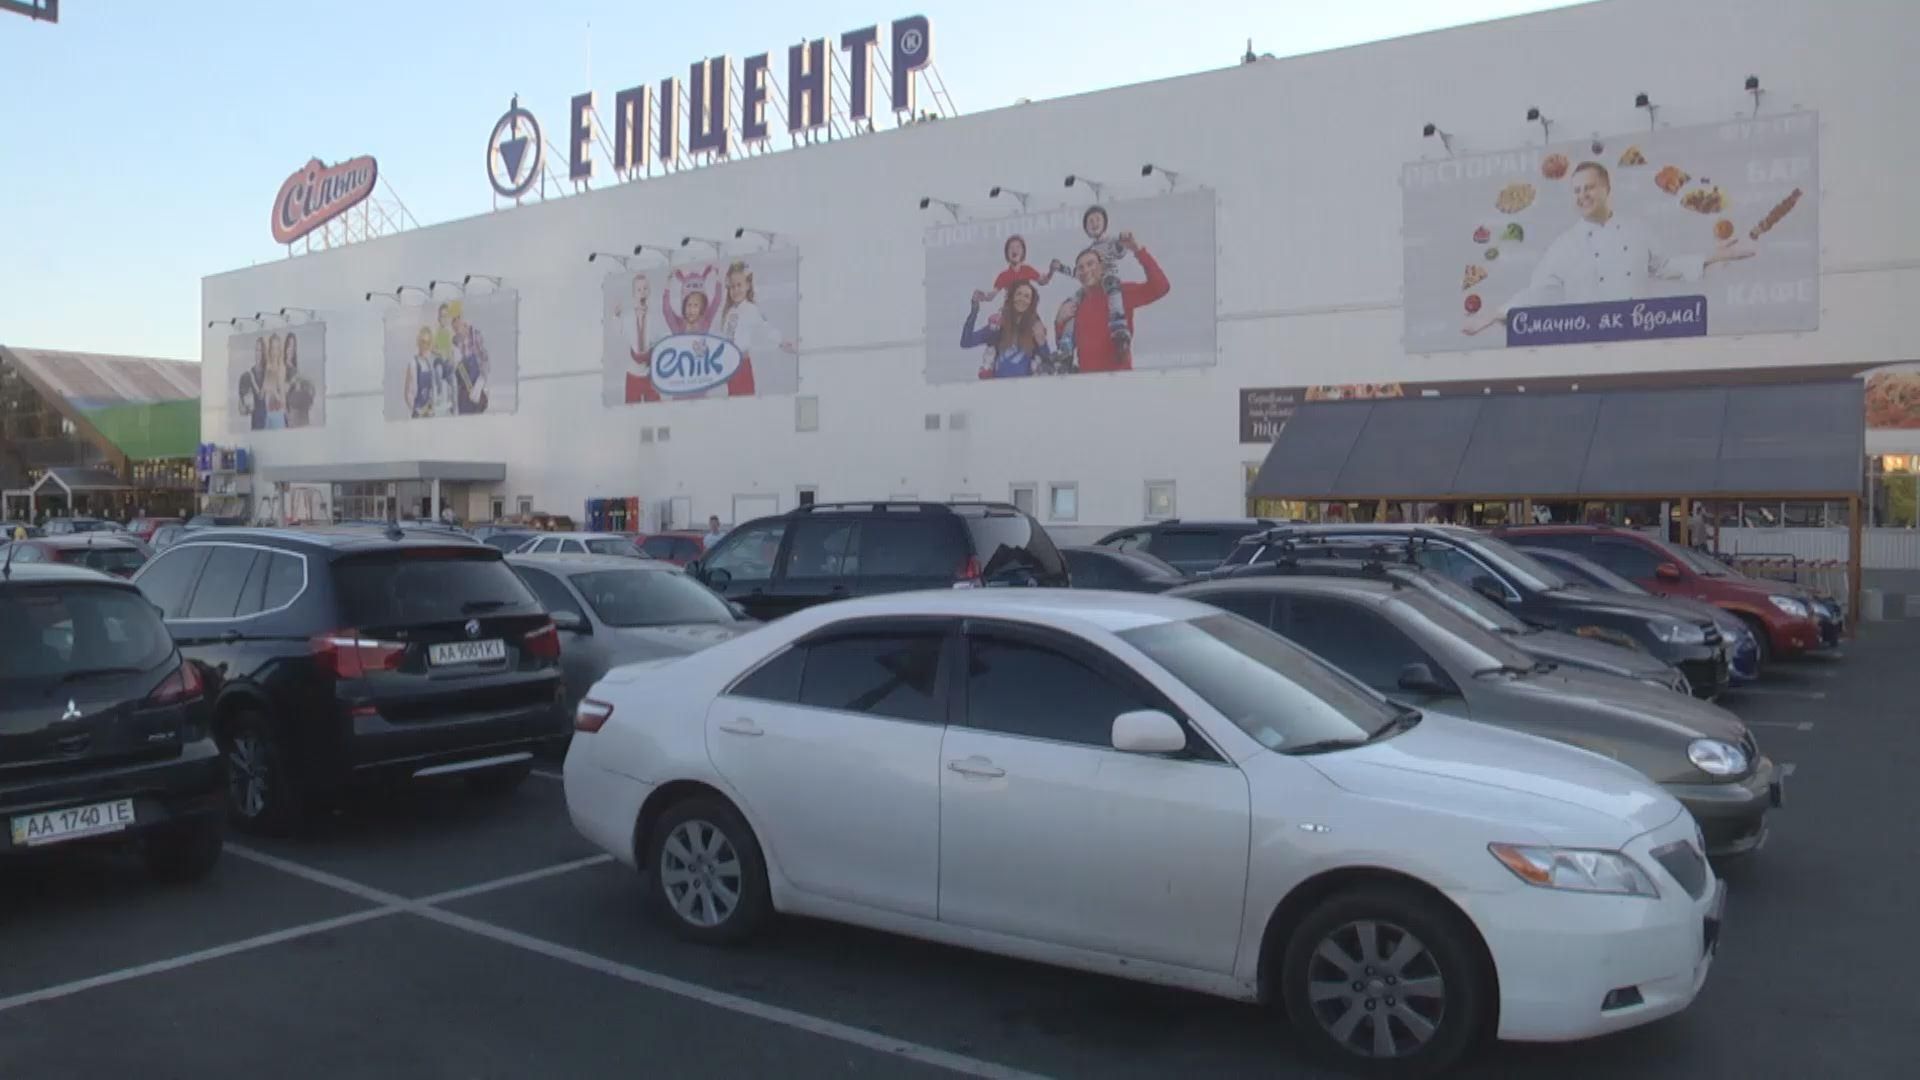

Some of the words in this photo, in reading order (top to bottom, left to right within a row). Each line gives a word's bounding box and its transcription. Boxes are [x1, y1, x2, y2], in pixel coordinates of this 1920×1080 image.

[569, 14, 931, 182] ЕПІЦЕНТР
[281, 168, 370, 228] Сільпо
[1512, 311, 1591, 335] Смачно,
[1599, 311, 1624, 329] як
[1632, 301, 1702, 331] вдома!
[59, 806, 101, 830] 1740
